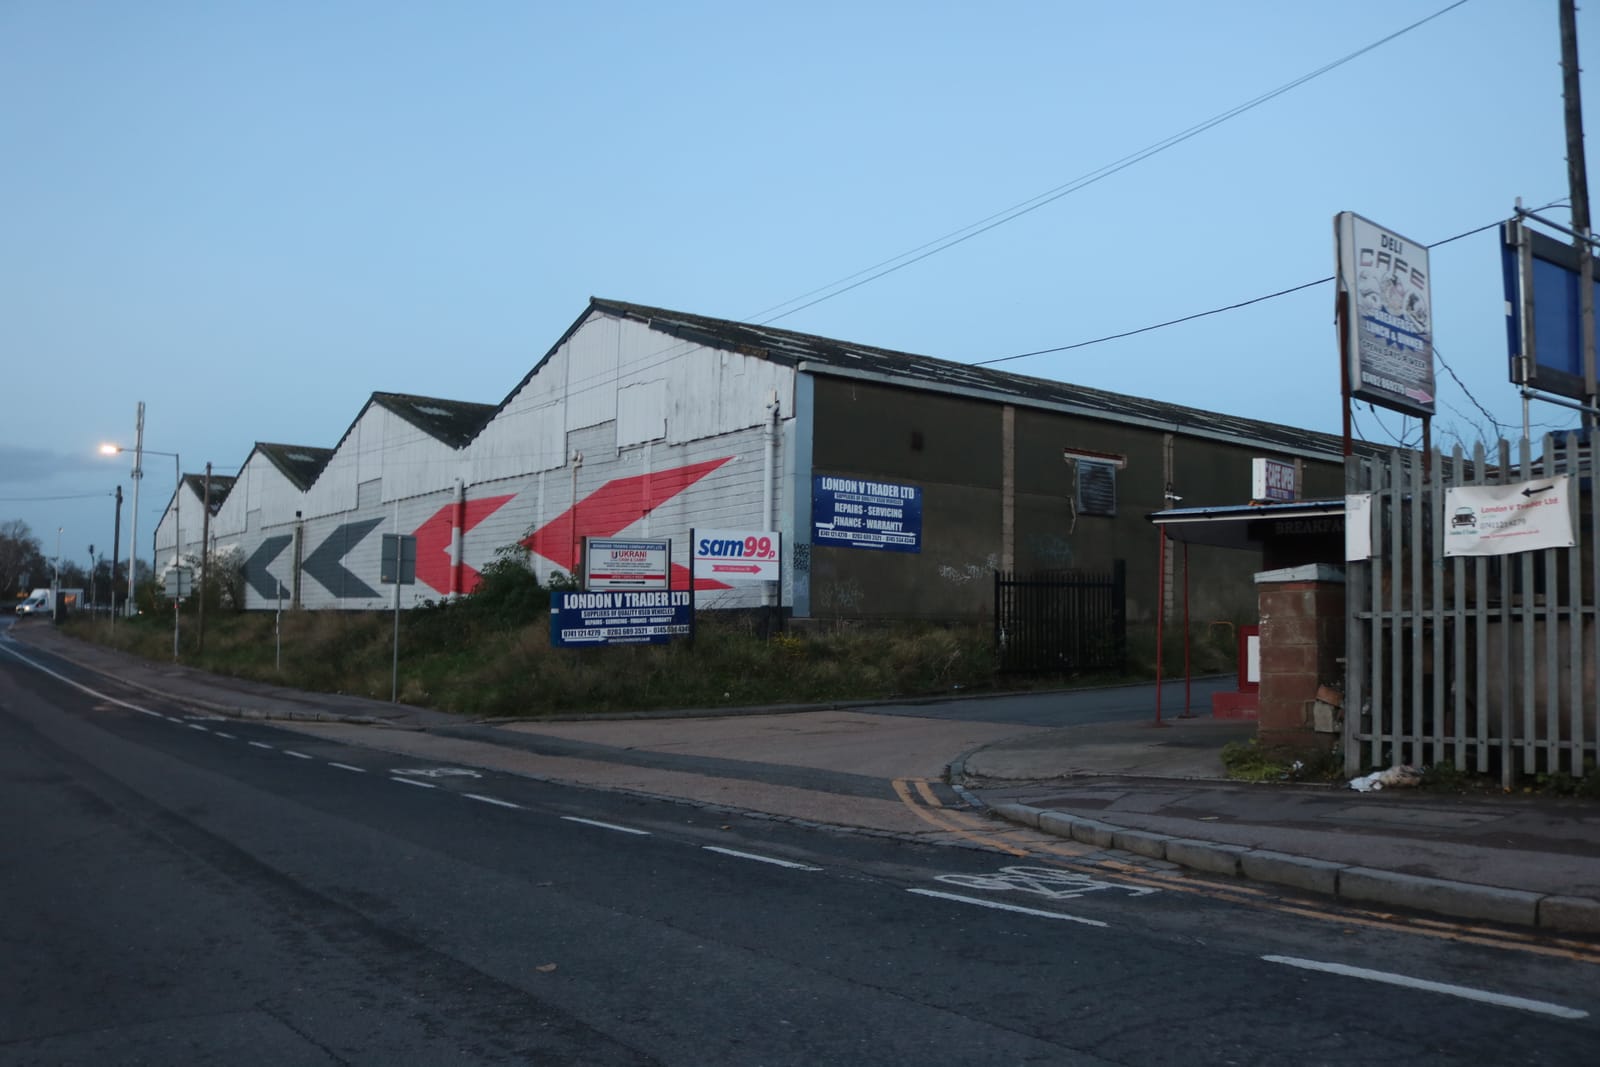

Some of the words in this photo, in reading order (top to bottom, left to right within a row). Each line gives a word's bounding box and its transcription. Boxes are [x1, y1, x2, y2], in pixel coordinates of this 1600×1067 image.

[1381, 233, 1402, 255] DELI
[1359, 248, 1425, 290] CAFE
[822, 477, 857, 493] LONDON
[859, 481, 865, 494] V
[866, 482, 899, 497] TRADER
[900, 486, 915, 499] LTD
[834, 502, 863, 515] REPAIRS
[867, 506, 903, 519] SERVICING
[1481, 506, 1507, 514] London
[833, 516, 862, 528] FINANCE
[866, 519, 903, 532] WARRANTY
[564, 594, 612, 609] LONDON
[614, 593, 623, 608] V
[624, 592, 669, 608] TRADER
[671, 591, 690, 606] LTD
